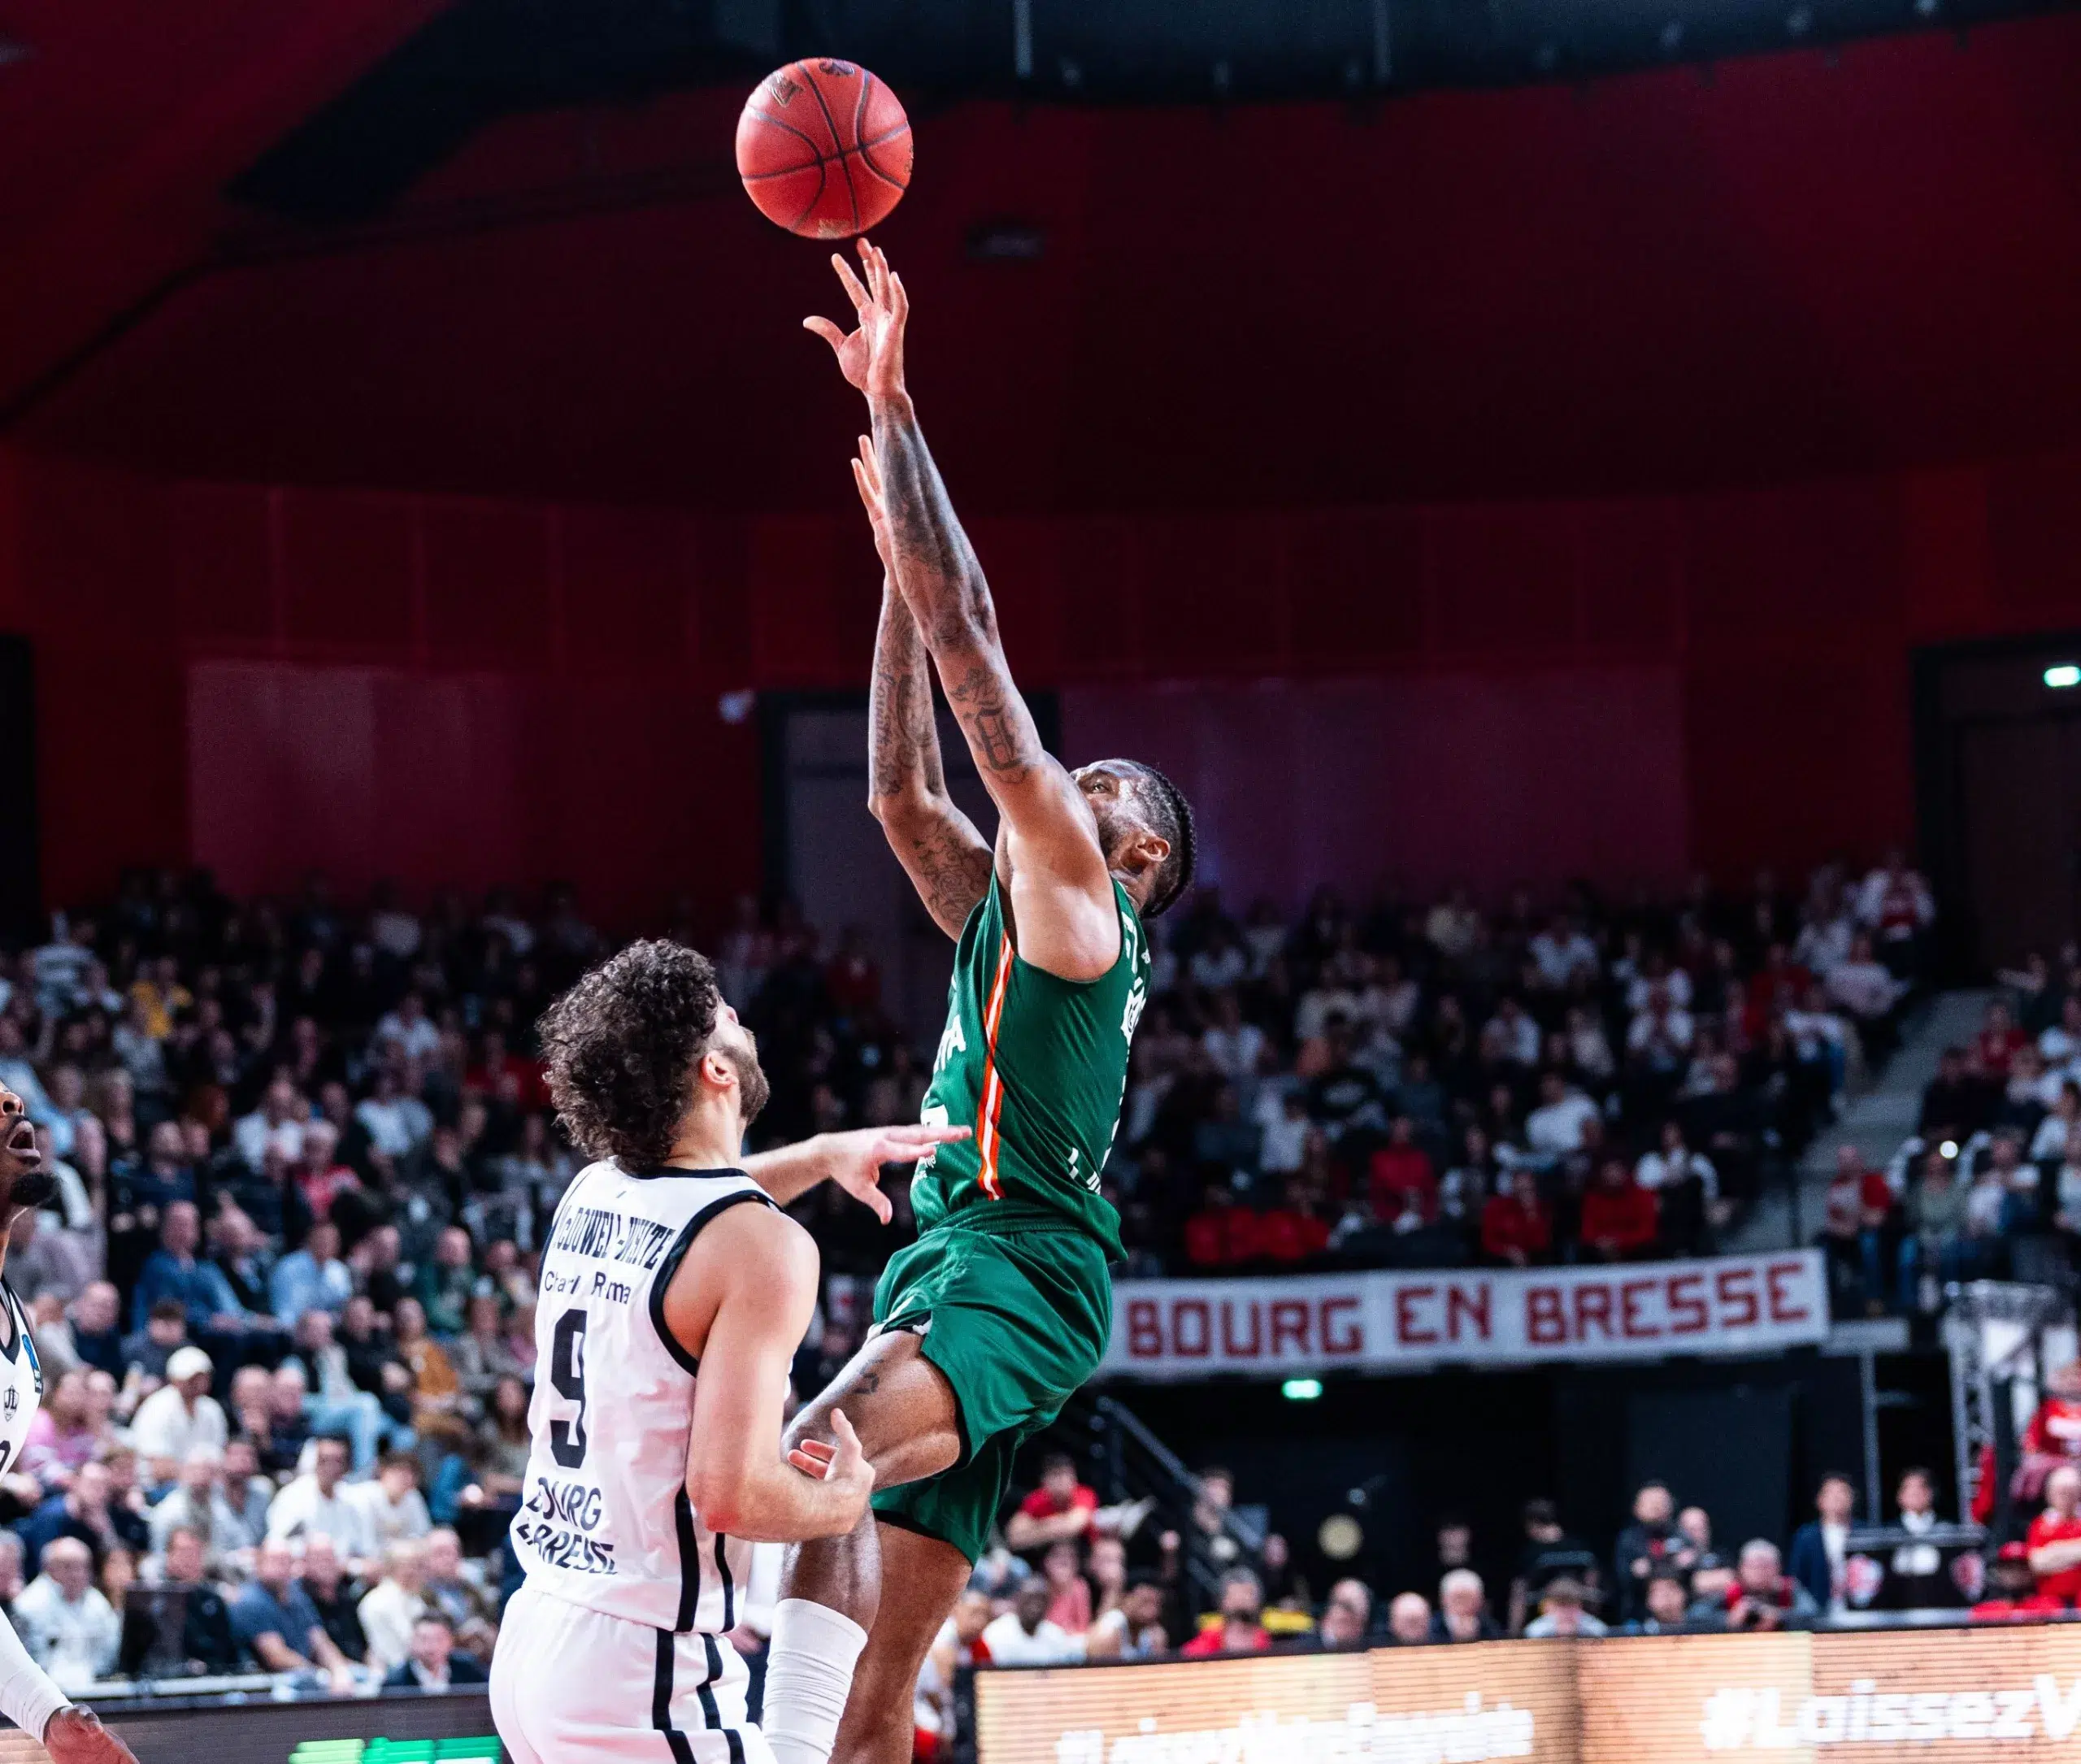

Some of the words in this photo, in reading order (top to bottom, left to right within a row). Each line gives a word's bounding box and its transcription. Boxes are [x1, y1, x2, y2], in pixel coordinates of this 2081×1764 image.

[1125, 1297, 1363, 1359] BOURG
[1393, 1282, 1492, 1346] EN
[1524, 1261, 1809, 1346] BRESSE
[550, 1308, 588, 1470] 9
